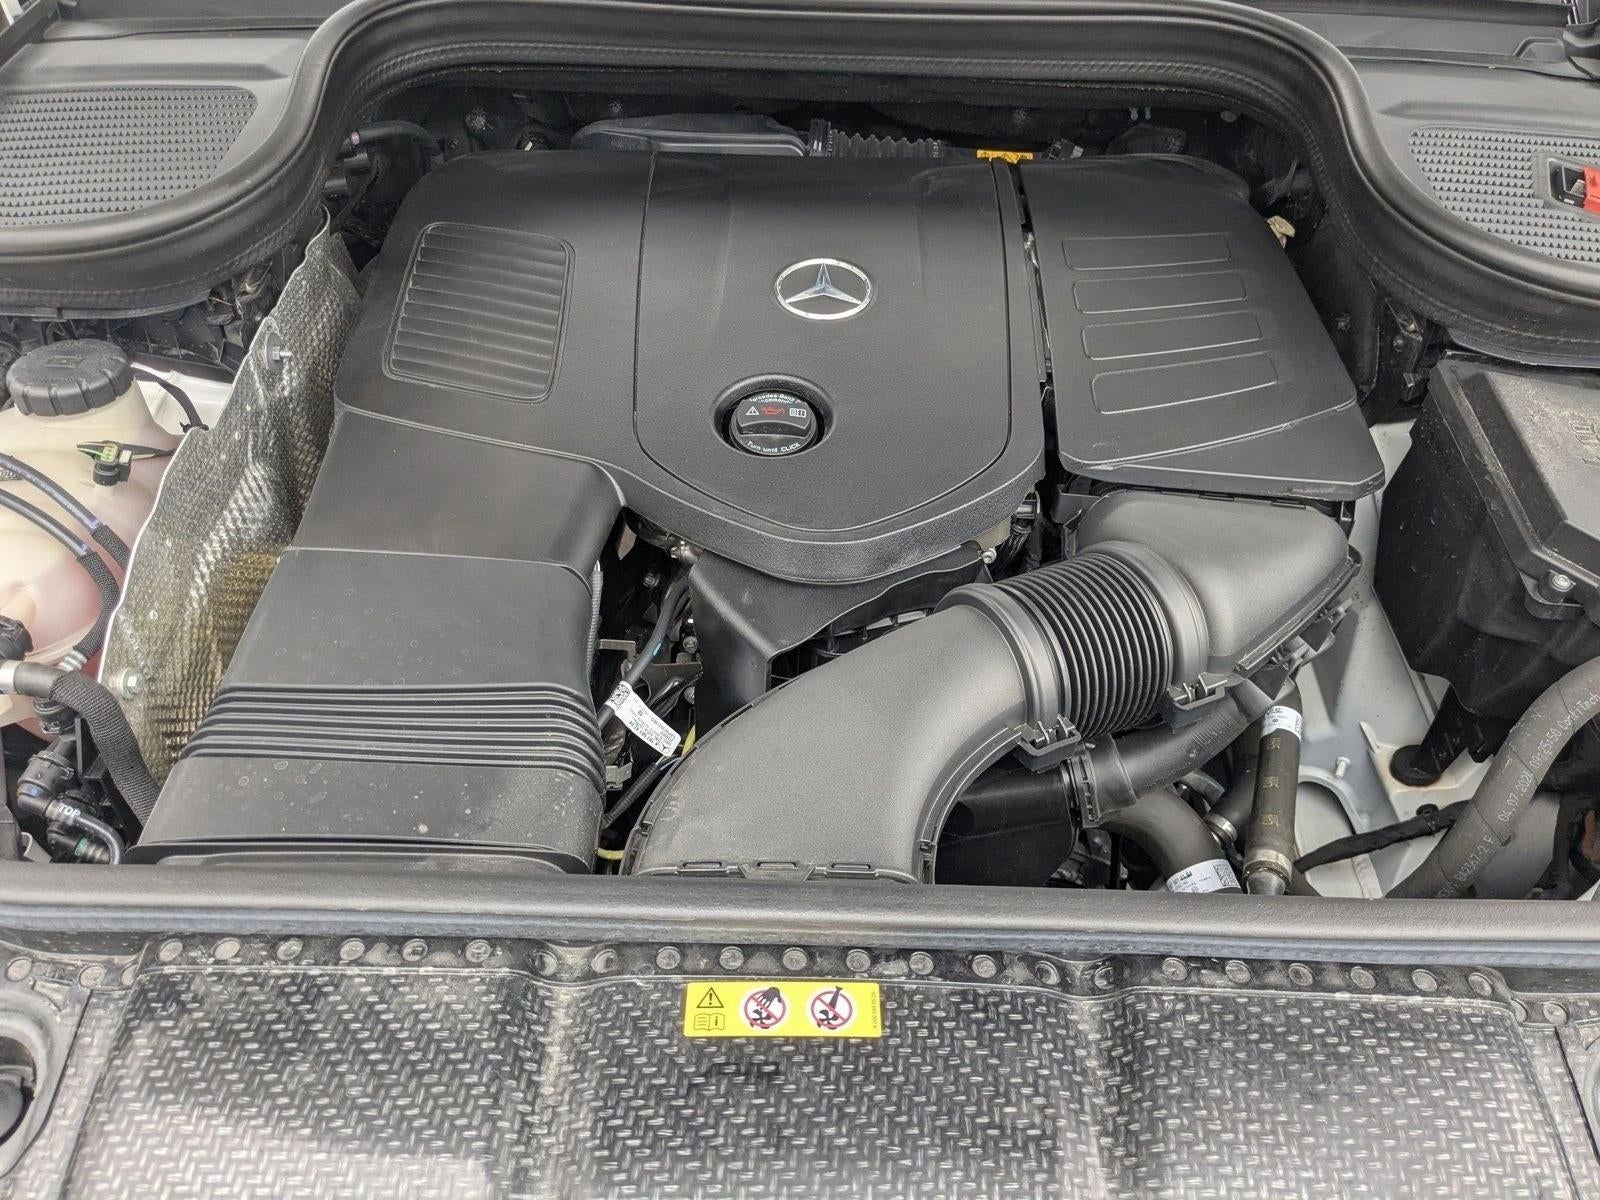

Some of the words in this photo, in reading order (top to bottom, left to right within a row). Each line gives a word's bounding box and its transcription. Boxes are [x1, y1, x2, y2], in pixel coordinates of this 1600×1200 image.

[747, 441, 761, 450] Turn
[780, 442, 801, 452] CLICK
[59, 802, 81, 817] TOP
